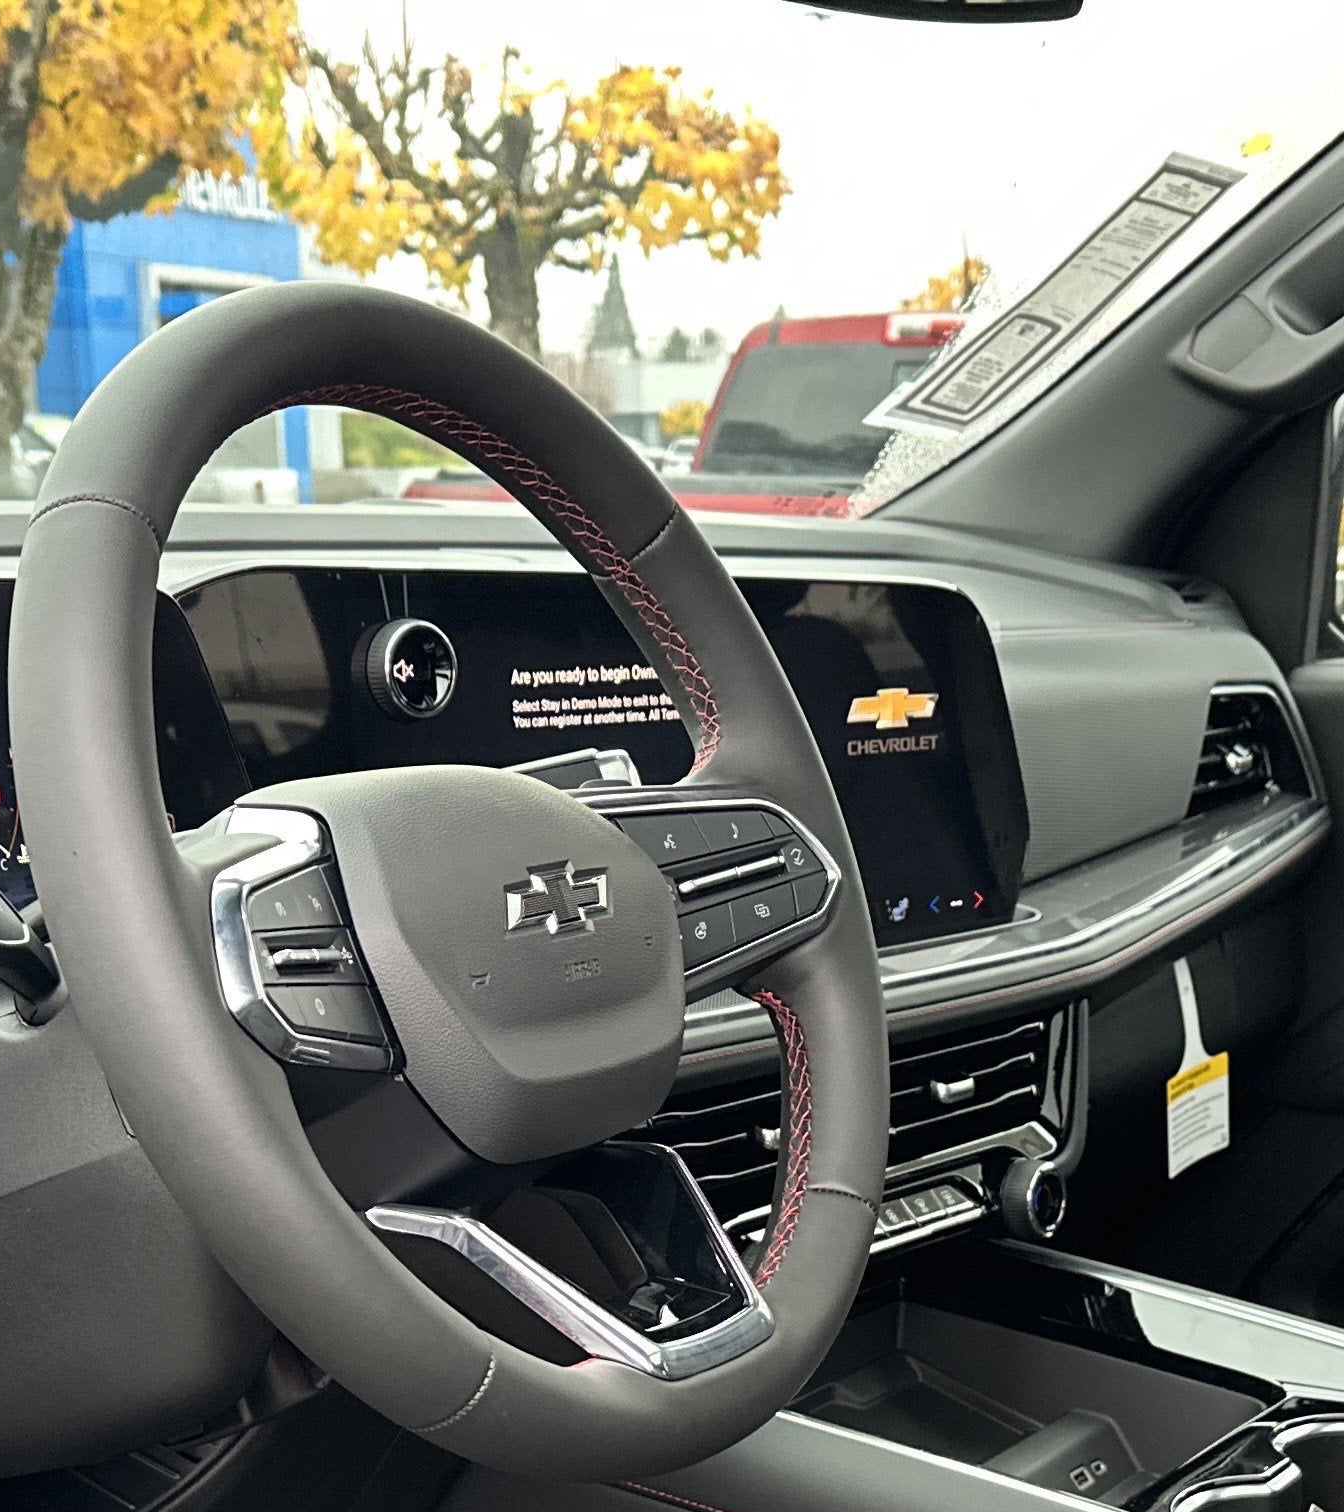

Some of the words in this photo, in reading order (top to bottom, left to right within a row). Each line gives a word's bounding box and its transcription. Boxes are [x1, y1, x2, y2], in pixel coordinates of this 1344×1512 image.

[510, 668, 532, 686] Are
[532, 669, 554, 688] you
[555, 666, 586, 687] ready
[587, 667, 599, 683] to
[600, 665, 630, 685] begin
[631, 664, 659, 681] Own
[512, 699, 540, 713] Select
[541, 698, 561, 713] Stay
[561, 698, 570, 711] in
[571, 696, 597, 711] Demo
[597, 695, 622, 710] Mode
[622, 696, 632, 709] to
[632, 694, 648, 708] exit
[649, 694, 659, 706] to
[512, 715, 531, 729] You
[532, 715, 549, 728] can
[550, 712, 582, 730] register
[583, 712, 593, 725] at
[593, 711, 625, 726] another
[626, 710, 647, 723] time.
[648, 708, 660, 722] All
[847, 734, 939, 757] CHEVROLET
[0, 857, 9, 872] C
